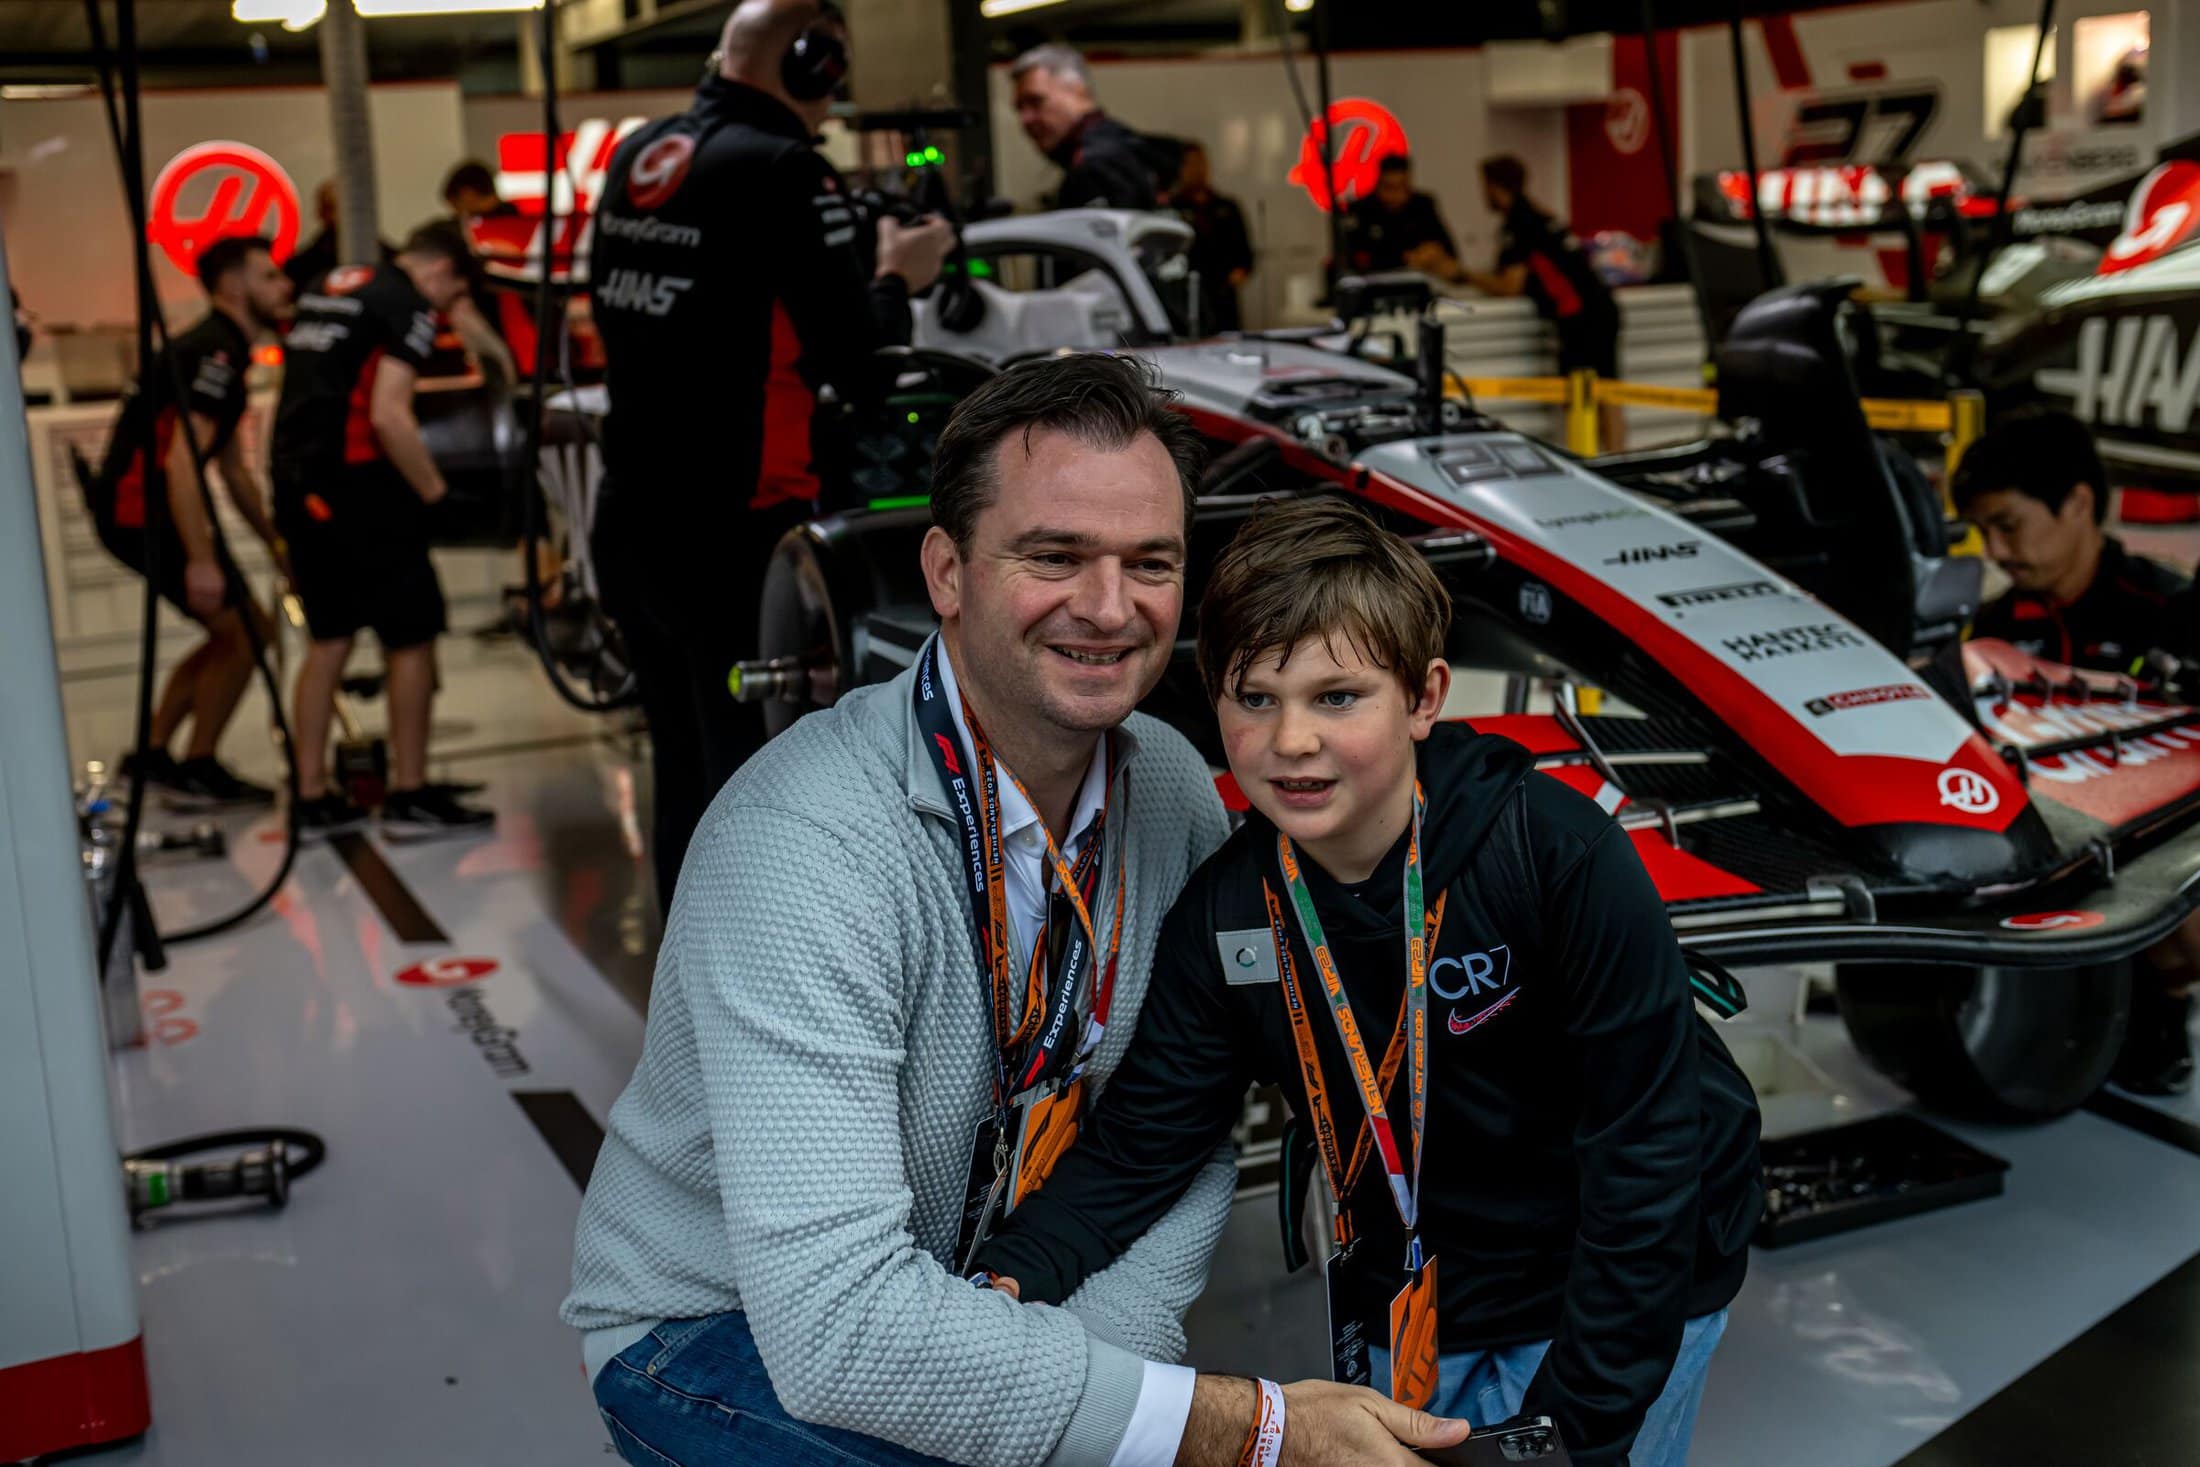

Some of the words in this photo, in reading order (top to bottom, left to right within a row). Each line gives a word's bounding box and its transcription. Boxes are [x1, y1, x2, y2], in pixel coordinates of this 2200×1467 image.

[1603, 540, 1701, 566] HAAS
[1656, 580, 1780, 608] PIRELLI
[1722, 623, 1840, 652] HANTEC
[1738, 632, 1866, 663] MARKETS
[952, 777, 985, 893] Experiences
[1315, 945, 1341, 997] VIP23
[1411, 937, 1425, 988] VIP23
[1429, 944, 1511, 1000] CR7
[1043, 939, 1082, 1049] Experiences
[1415, 1009, 1424, 1039] 2030
[1336, 1006, 1384, 1115] NETHERLANDS
[1265, 1420, 1276, 1457] FRIDAY
